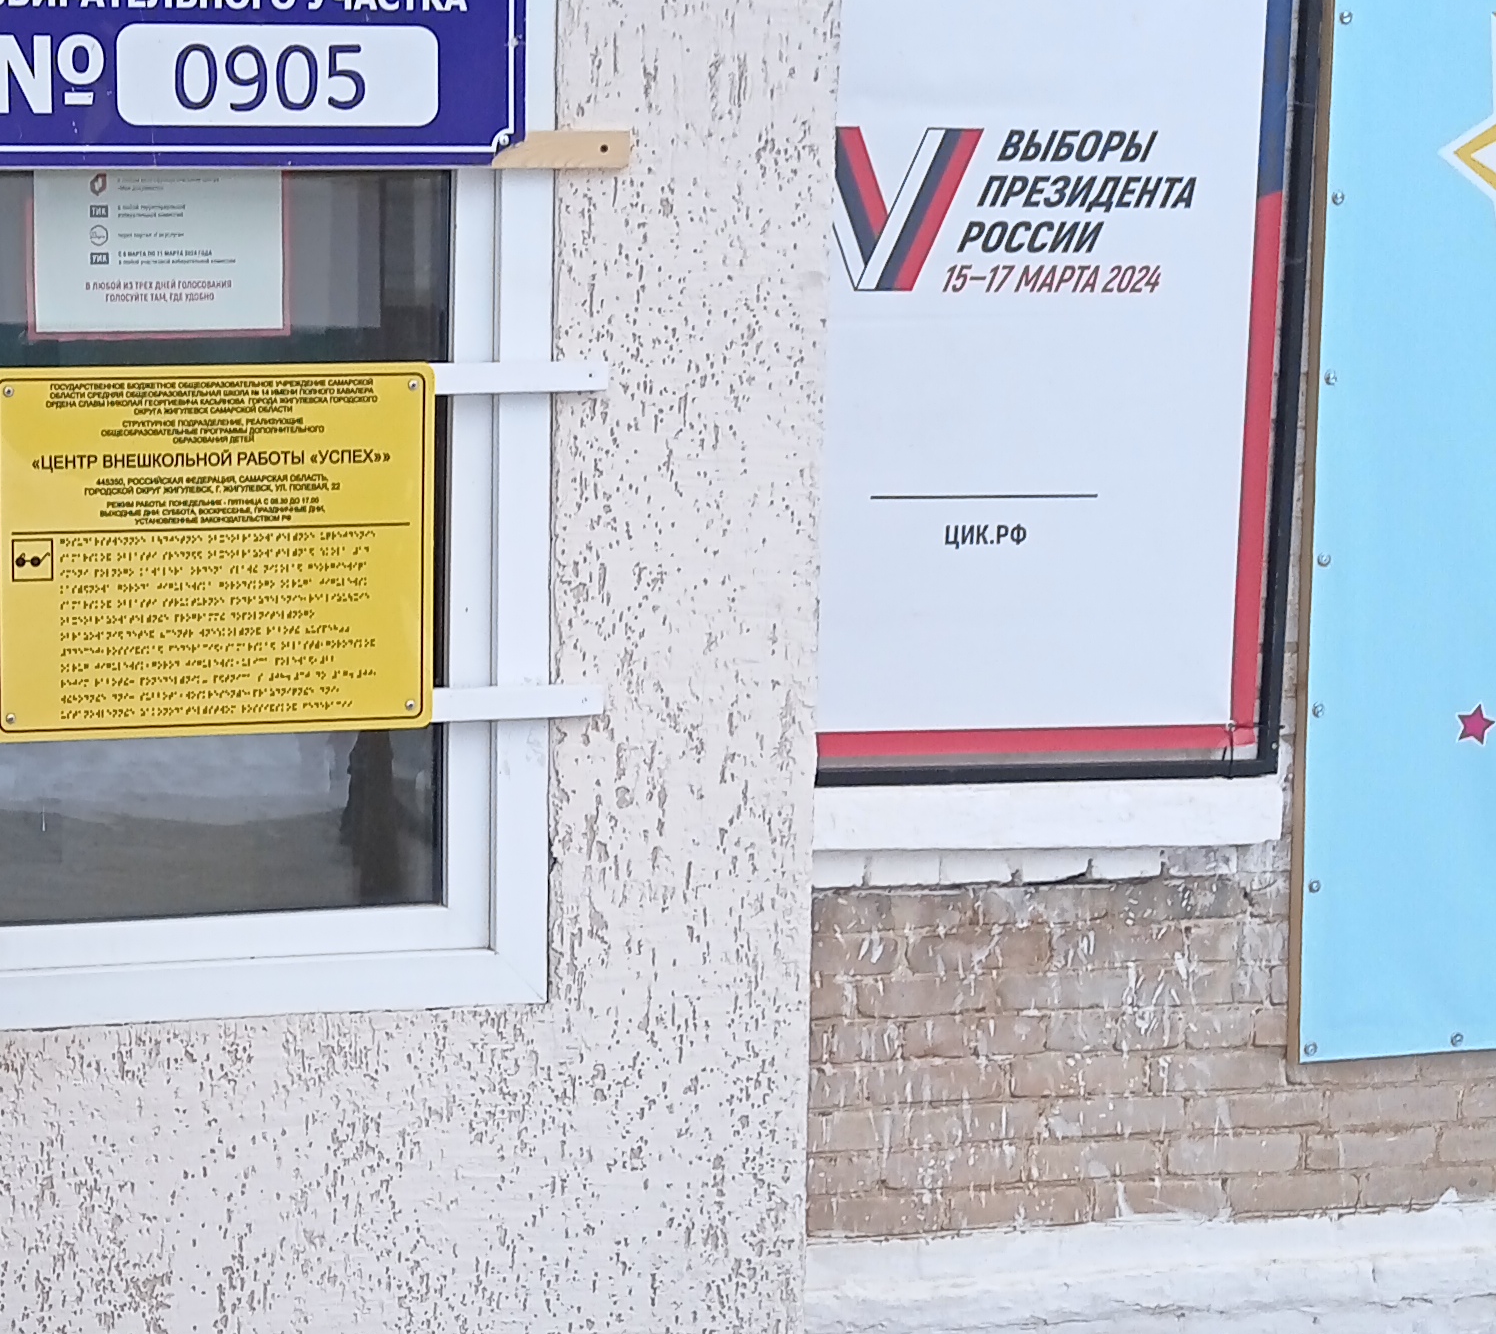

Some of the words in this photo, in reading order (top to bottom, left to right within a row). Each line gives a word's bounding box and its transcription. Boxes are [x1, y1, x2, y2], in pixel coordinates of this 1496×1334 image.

[173, 42, 367, 113] 0905
[997, 129, 1158, 163] ВЫБОРЫ
[976, 175, 1197, 213] ПРЕЗИДЕНТА
[957, 220, 1104, 254] РОССИИ
[1013, 264, 1101, 293] МАРТА
[1100, 264, 1162, 294] 2024
[32, 454, 98, 473] «ЦЕНТР
[102, 449, 232, 469] ВНЕШКОЛЬНОЙ
[237, 450, 305, 467] РАБОТЫ
[310, 449, 392, 466] «УСПЕХ»»
[944, 523, 1028, 549] ЦИК.РФ
